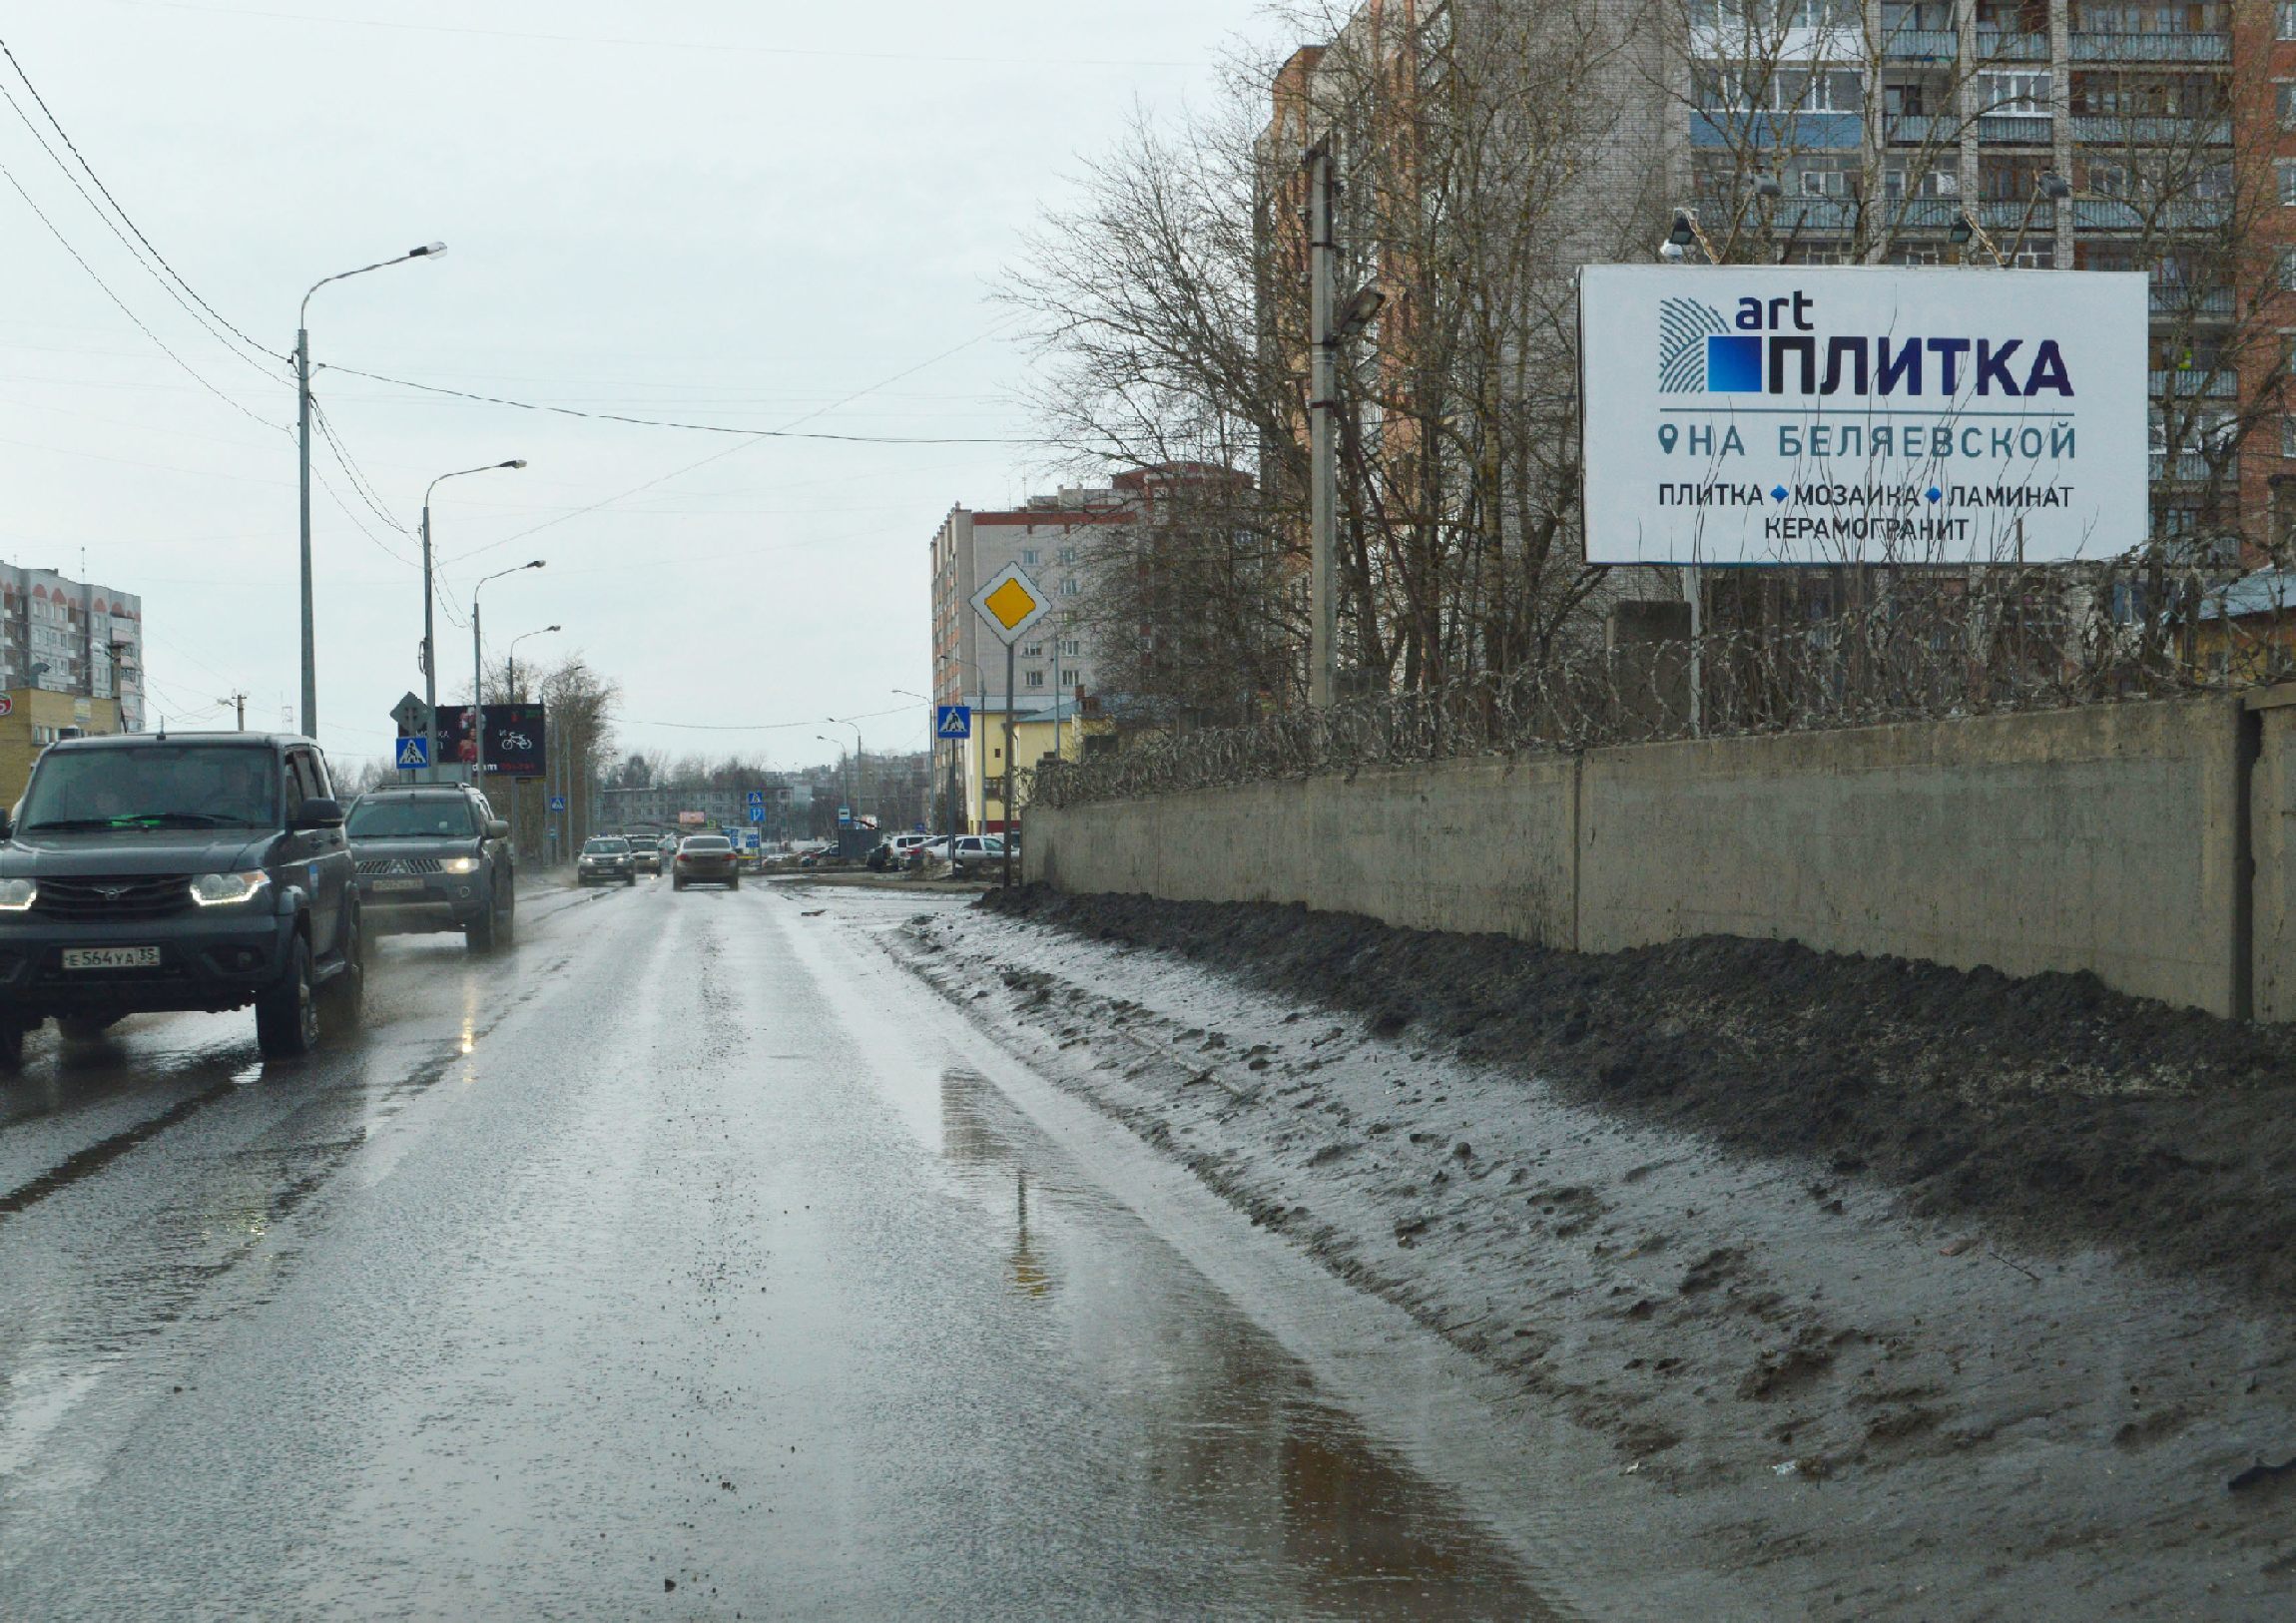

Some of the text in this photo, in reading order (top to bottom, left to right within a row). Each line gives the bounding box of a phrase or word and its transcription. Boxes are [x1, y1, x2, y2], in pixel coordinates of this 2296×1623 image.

[1735, 289, 1815, 330] art
[1768, 335, 2075, 397] ПЛИТКА
[1689, 421, 2075, 459] НА БЕЛЯЕВСКОЙ
[1659, 483, 2075, 509] ПЛИТКА МОЗАИКА ЛАМИНАТ
[1765, 516, 1970, 542] КЕРАМОГРАНИТ
